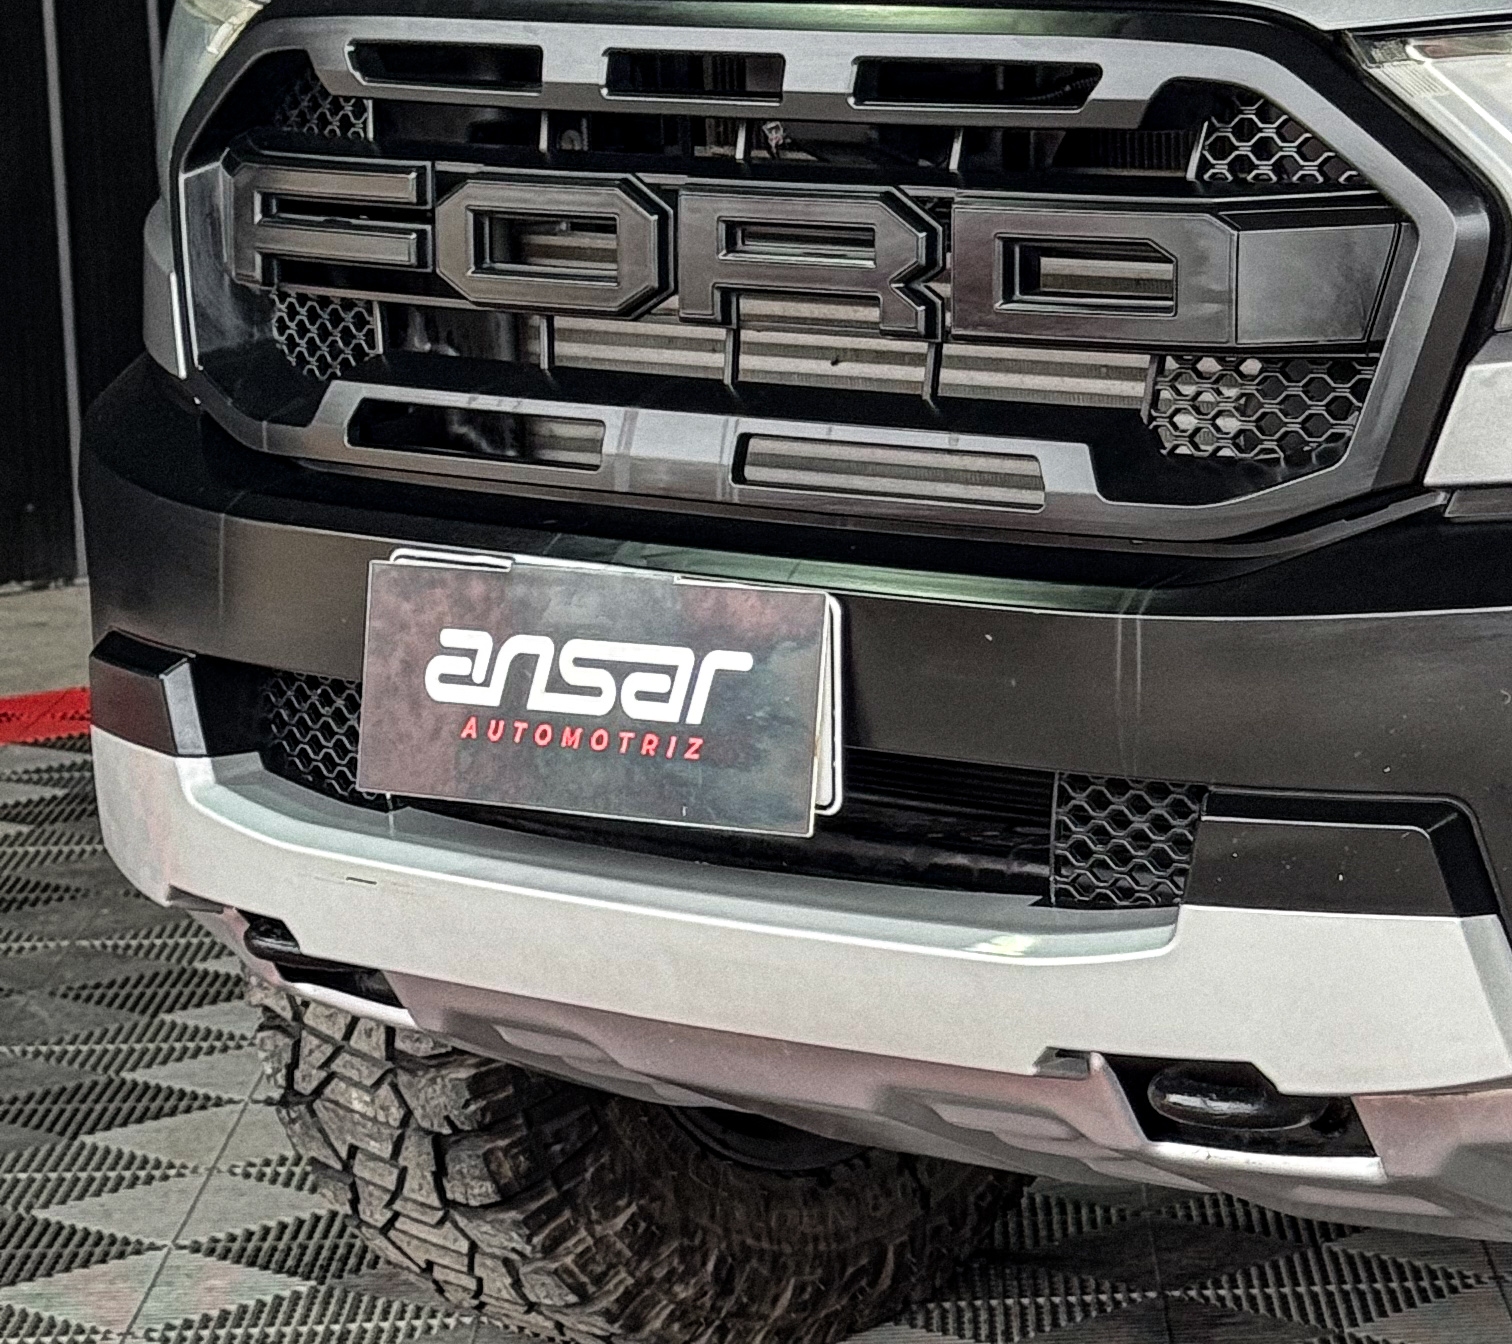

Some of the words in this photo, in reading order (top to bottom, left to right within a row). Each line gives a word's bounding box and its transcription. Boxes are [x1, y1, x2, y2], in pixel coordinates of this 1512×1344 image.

[226, 153, 1238, 346] FORD
[425, 628, 753, 724] ansar
[461, 716, 704, 760] AUTOMOTRIZ
